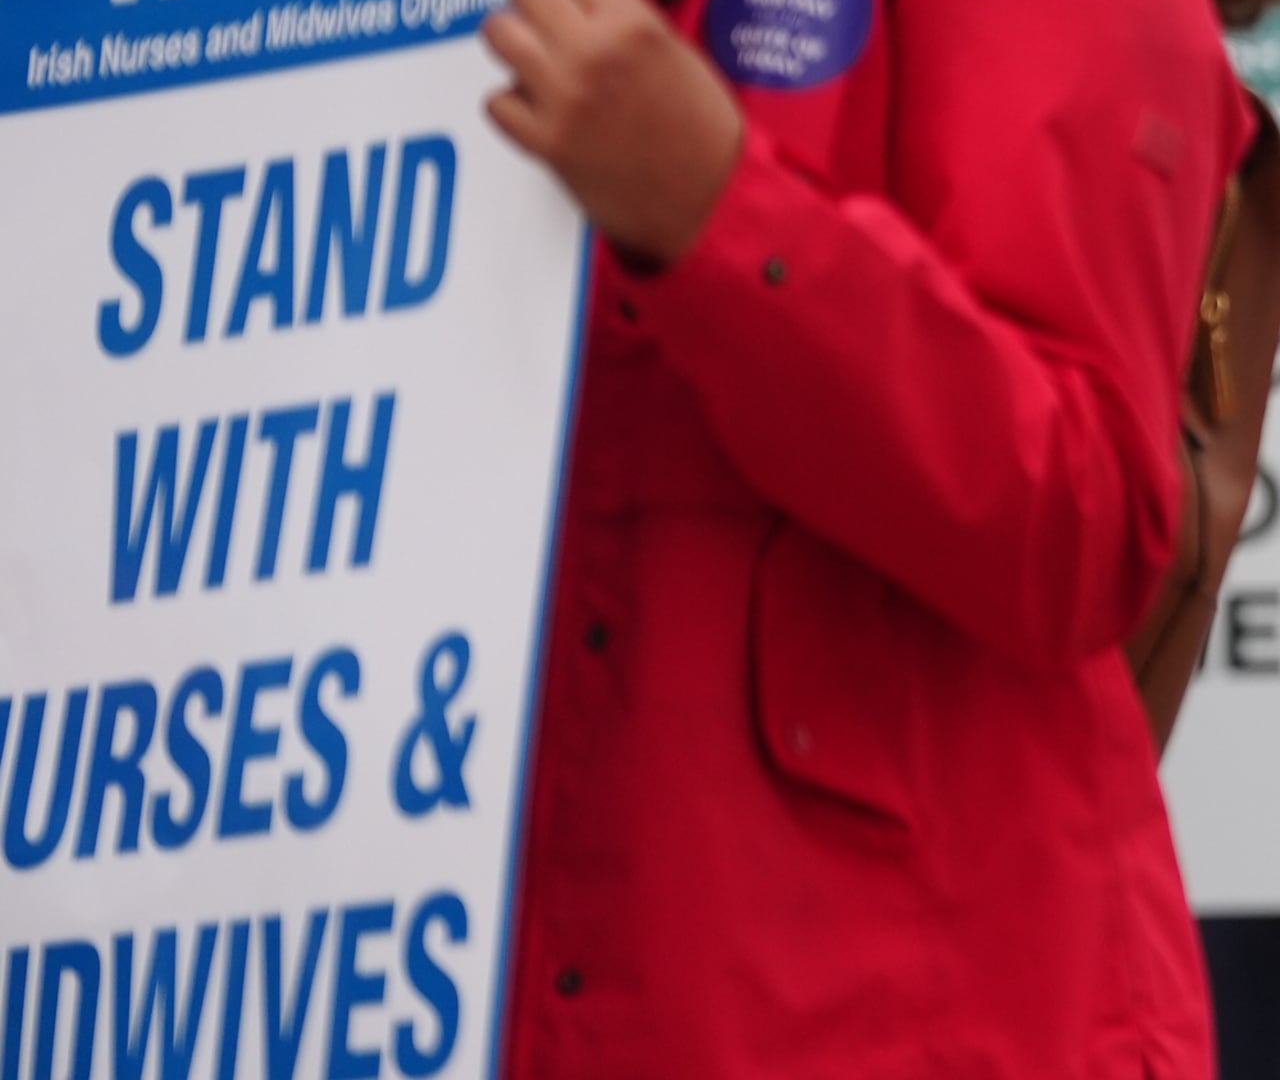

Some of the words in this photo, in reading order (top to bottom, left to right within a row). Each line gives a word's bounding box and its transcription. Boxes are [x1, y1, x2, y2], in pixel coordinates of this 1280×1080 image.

[27, 37, 95, 90] Irish
[99, 27, 202, 80] Nurses
[205, 7, 263, 64] and
[96, 135, 457, 359] STAND
[108, 389, 397, 605] WITH
[0, 646, 361, 871] URSES
[390, 630, 478, 819] &
[4, 889, 470, 1080] IDWIVES
